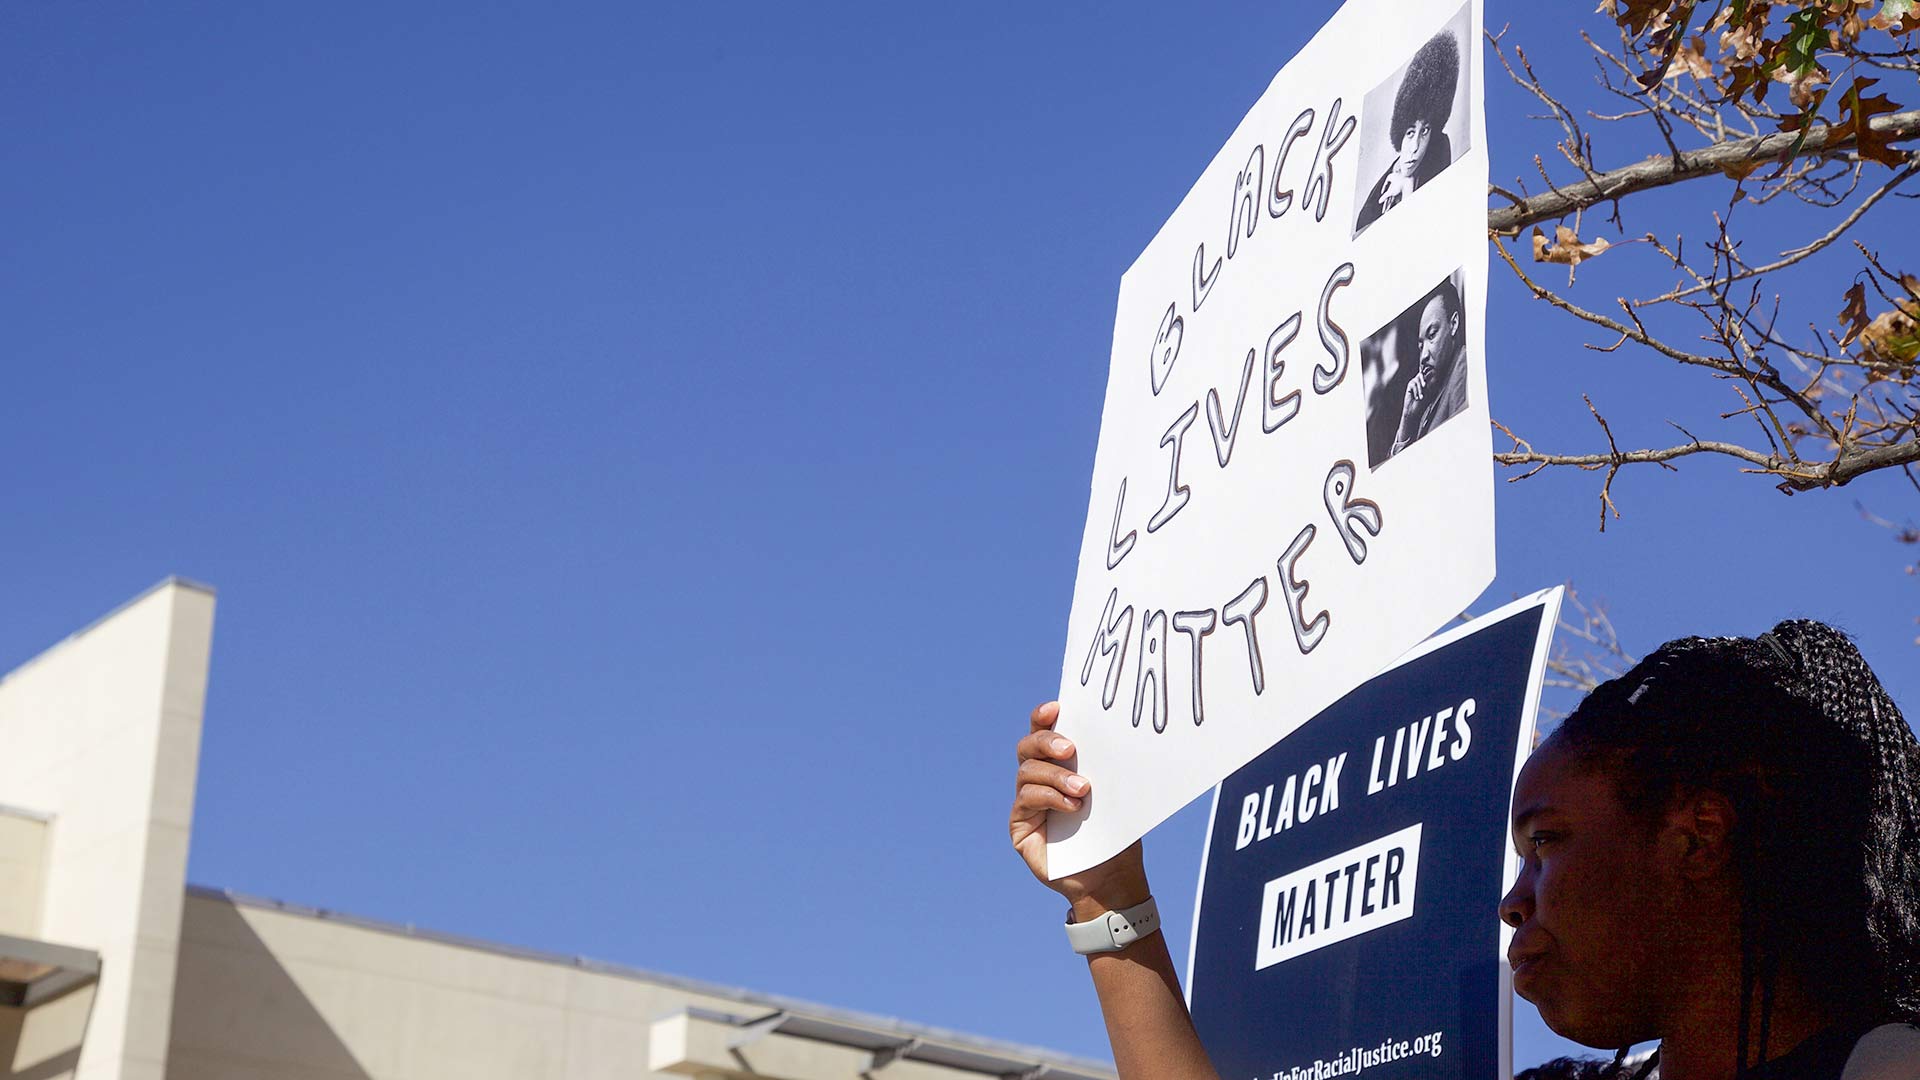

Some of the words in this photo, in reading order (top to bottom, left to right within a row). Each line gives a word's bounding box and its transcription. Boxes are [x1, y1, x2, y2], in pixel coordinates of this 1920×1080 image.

[1151, 97, 1357, 396] BLACK
[1107, 262, 1354, 570] LIVES
[1081, 460, 1383, 733] MATTER
[1235, 752, 1347, 851] BLACK
[1367, 698, 1476, 796] LIVES
[1272, 846, 1405, 949] MATTER
[1254, 1031, 1442, 1080] ForRacialJustice.org
